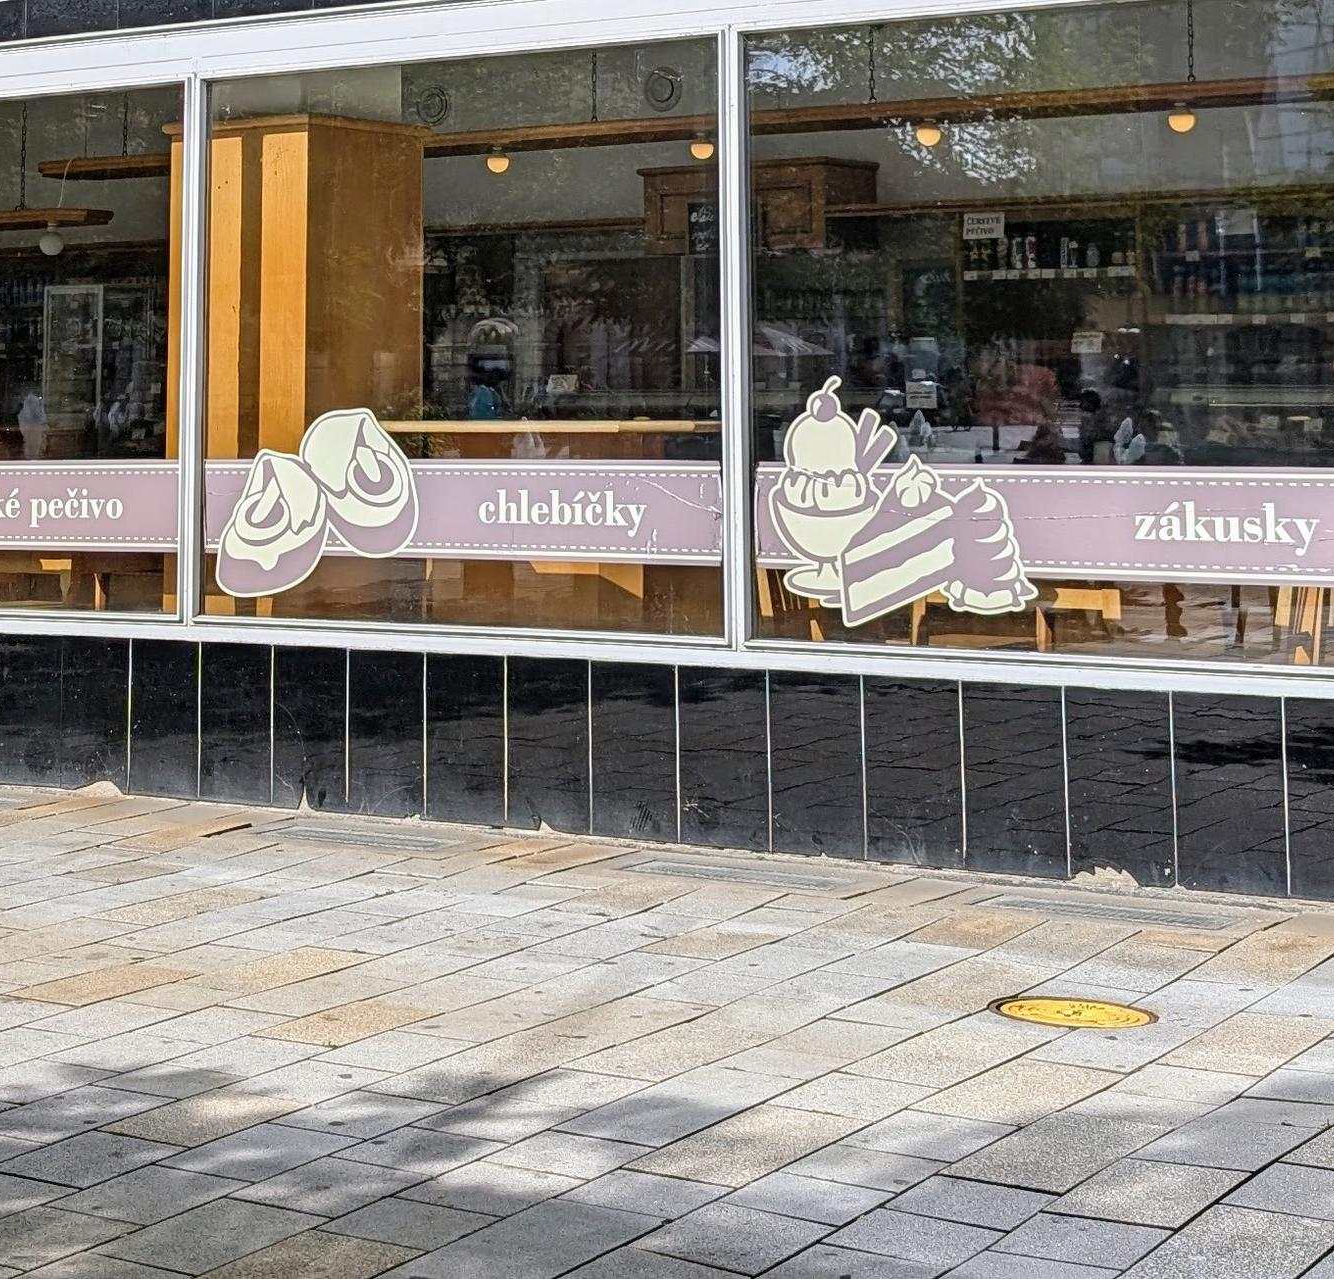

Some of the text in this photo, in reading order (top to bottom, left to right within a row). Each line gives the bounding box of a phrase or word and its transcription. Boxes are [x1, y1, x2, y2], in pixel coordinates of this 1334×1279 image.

[29, 488, 123, 528] pečivo
[478, 489, 647, 537] chlebíčky
[1135, 501, 1320, 556] zákusky
